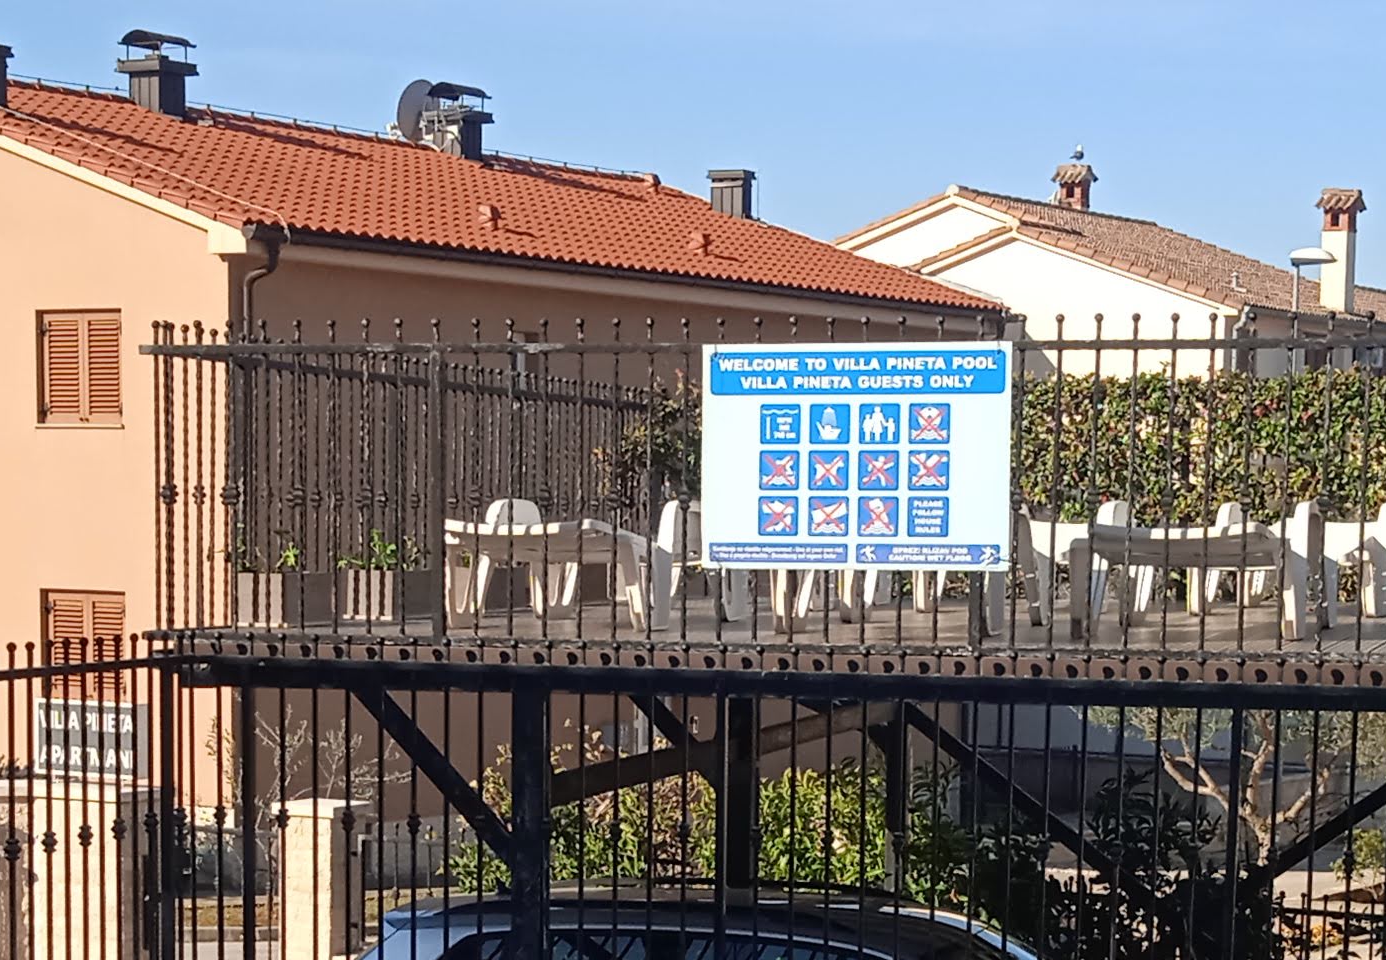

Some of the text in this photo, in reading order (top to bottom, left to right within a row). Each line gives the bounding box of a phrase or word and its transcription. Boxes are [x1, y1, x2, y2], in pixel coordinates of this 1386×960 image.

[718, 356, 998, 372] WELCOME TO VILLA PINETA POOL
[740, 374, 974, 389] VILLA PINETA GUESTS ONLY
[39, 709, 133, 734] VILA PINEA
[40, 744, 133, 769] APRMANI
